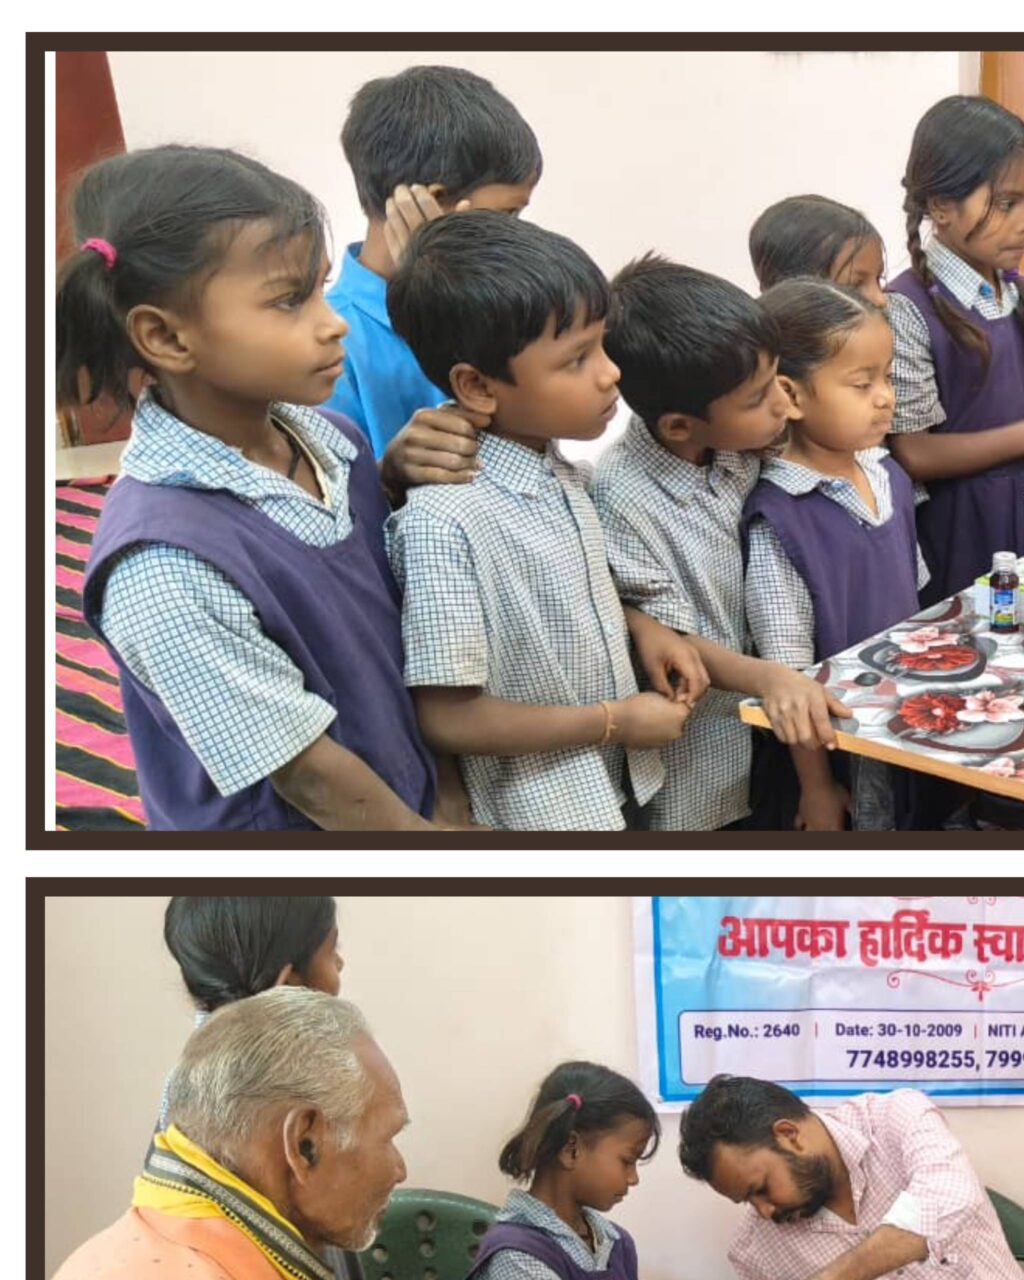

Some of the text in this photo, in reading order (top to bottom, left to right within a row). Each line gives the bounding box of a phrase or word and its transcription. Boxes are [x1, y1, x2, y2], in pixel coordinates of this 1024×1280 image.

[717, 916, 850, 958] आपका
[858, 909, 967, 966] हार्दिक
[694, 1023, 758, 1041] Reg.No.:
[763, 1023, 800, 1038] 2640
[835, 1022, 873, 1037] Date:
[878, 1023, 963, 1038] 30-10-2009
[988, 1024, 1017, 1038] NITI
[846, 1049, 981, 1071] 7748998255,
